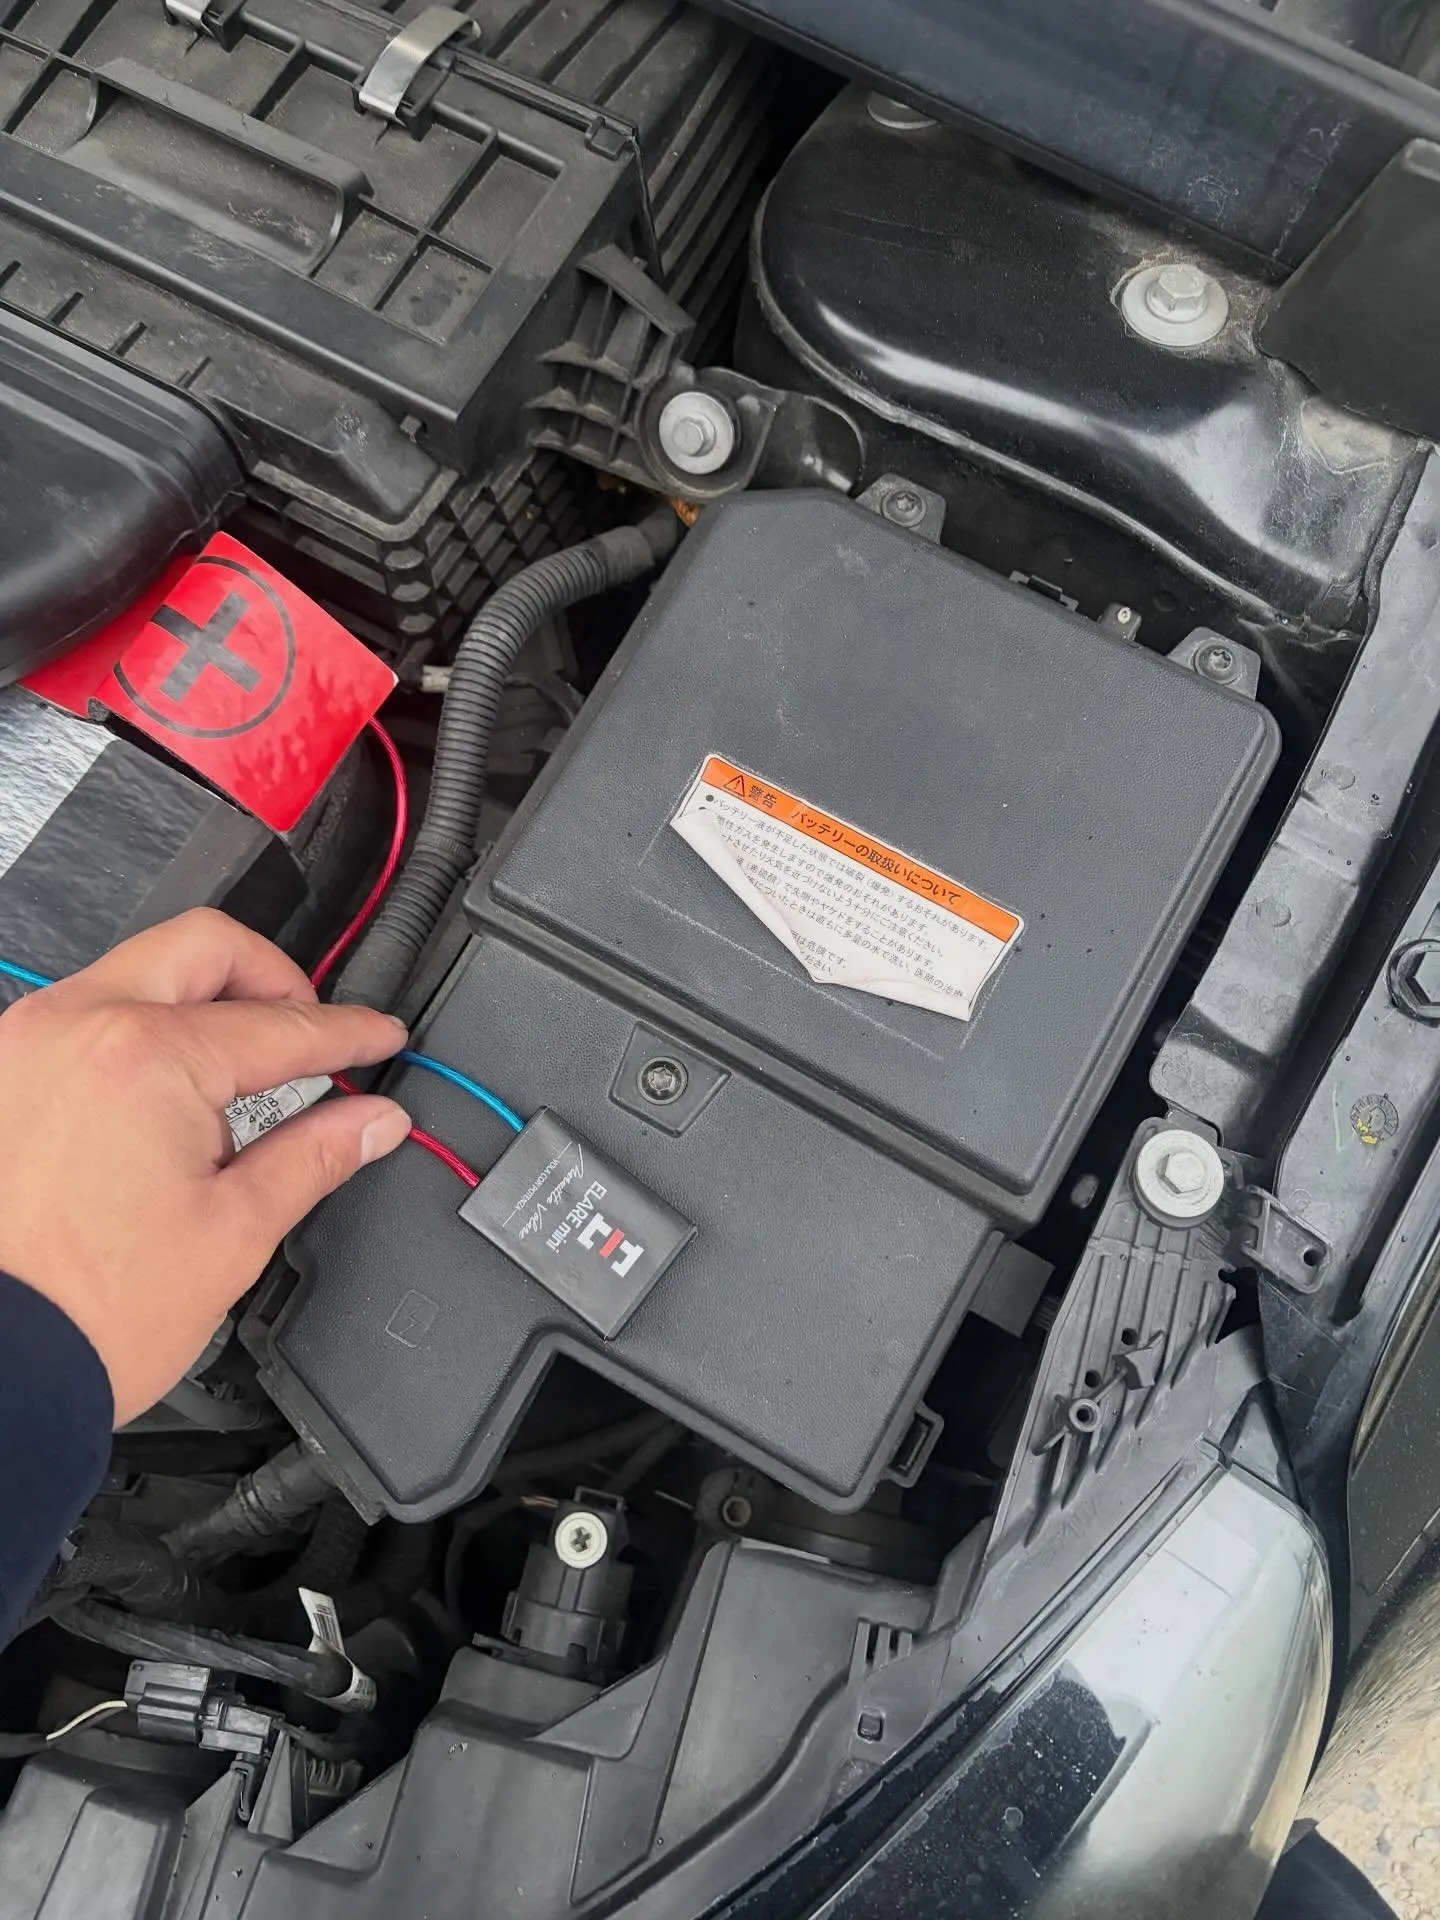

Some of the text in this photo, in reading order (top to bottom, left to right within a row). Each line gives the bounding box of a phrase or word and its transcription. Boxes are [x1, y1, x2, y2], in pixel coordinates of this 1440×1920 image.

[747, 784, 961, 906] 警告 バッテリーの取扱いについて
[258, 1110, 285, 1132] 4321
[545, 1158, 560, 1174] VOLA
[544, 1180, 607, 1253] ELARE mini
